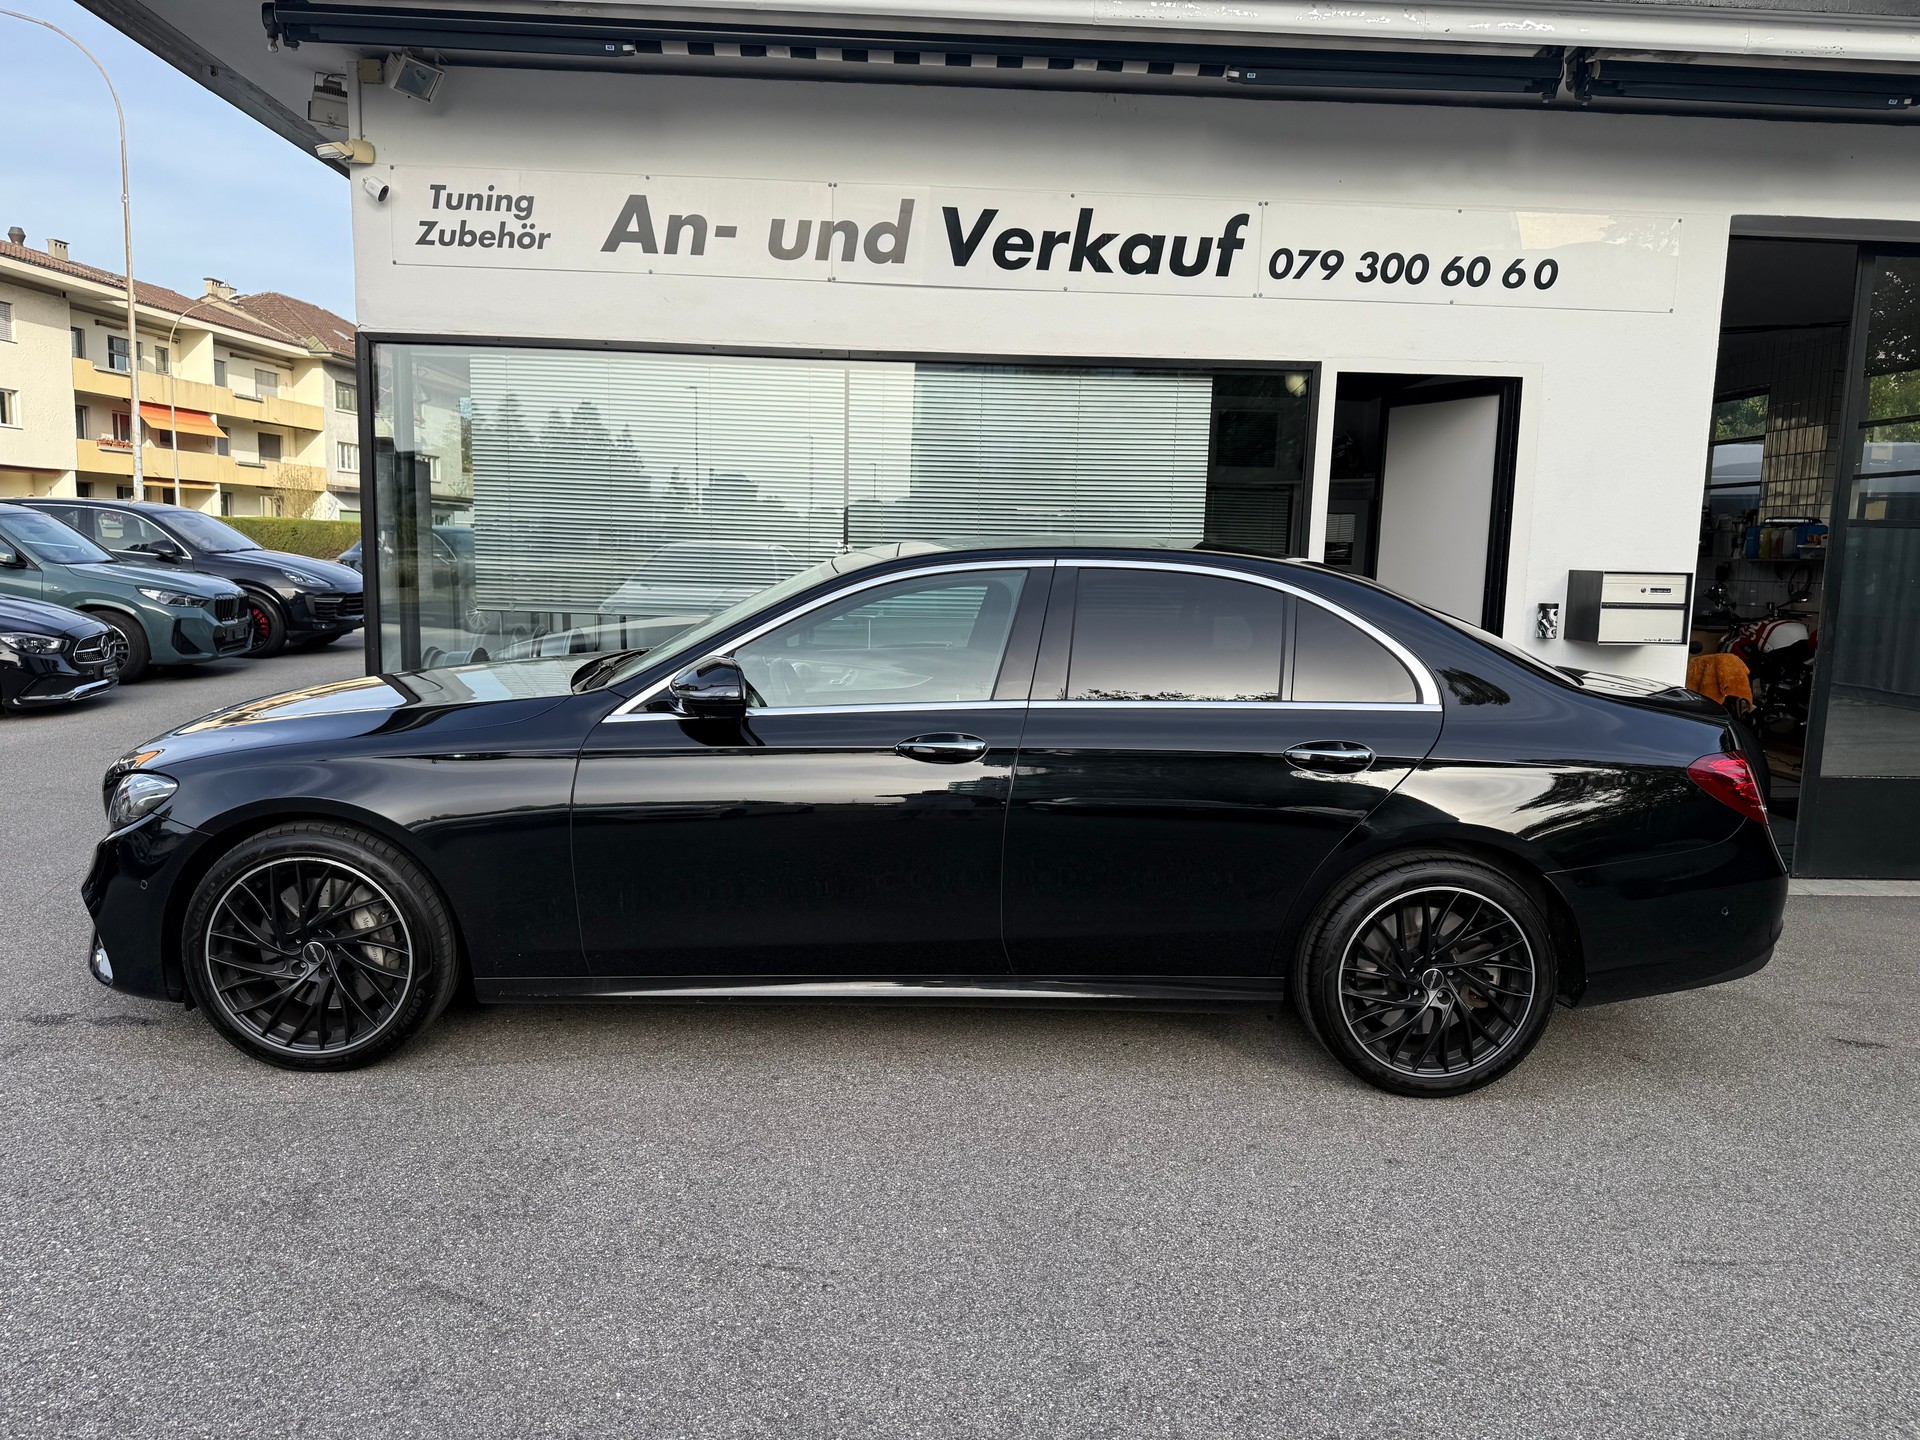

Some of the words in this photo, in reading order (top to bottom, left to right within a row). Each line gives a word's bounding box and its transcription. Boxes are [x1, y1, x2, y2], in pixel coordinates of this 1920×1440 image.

[430, 184, 535, 220] Tuning
[415, 219, 552, 250] Zubehör
[600, 194, 738, 256] An-
[767, 198, 916, 265] und
[942, 206, 1250, 278] Verkauf
[1268, 247, 1345, 281] 079
[1355, 251, 1430, 286] 300
[1440, 255, 1491, 288] 60
